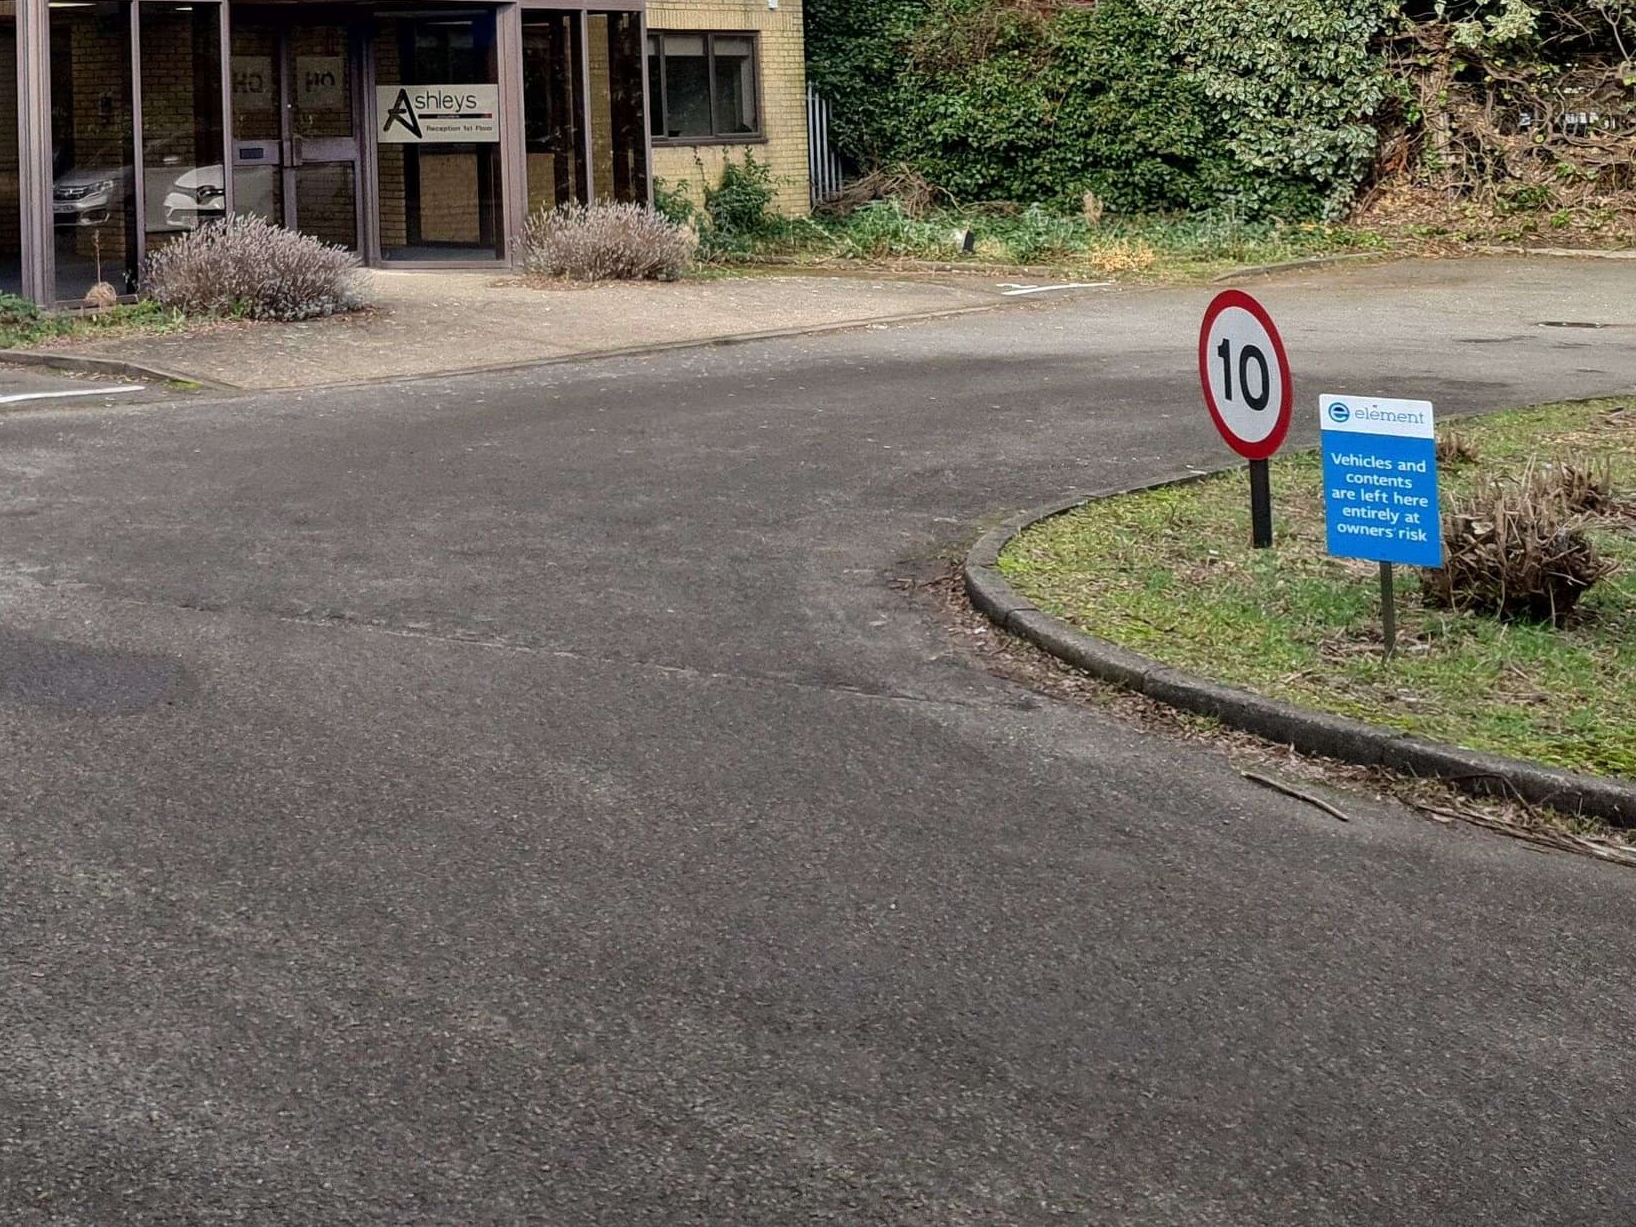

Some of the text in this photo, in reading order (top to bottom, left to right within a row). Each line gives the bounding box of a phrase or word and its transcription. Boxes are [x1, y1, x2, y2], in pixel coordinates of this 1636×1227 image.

[383, 88, 477, 139] Ashleys
[1217, 338, 1270, 411] 10
[1355, 407, 1424, 424] element
[1331, 453, 1427, 473] Vehicles and
[1346, 473, 1412, 488] contents
[1332, 488, 1429, 508] are left here
[1342, 506, 1421, 525] entirely at
[1398, 528, 1428, 542] risk
